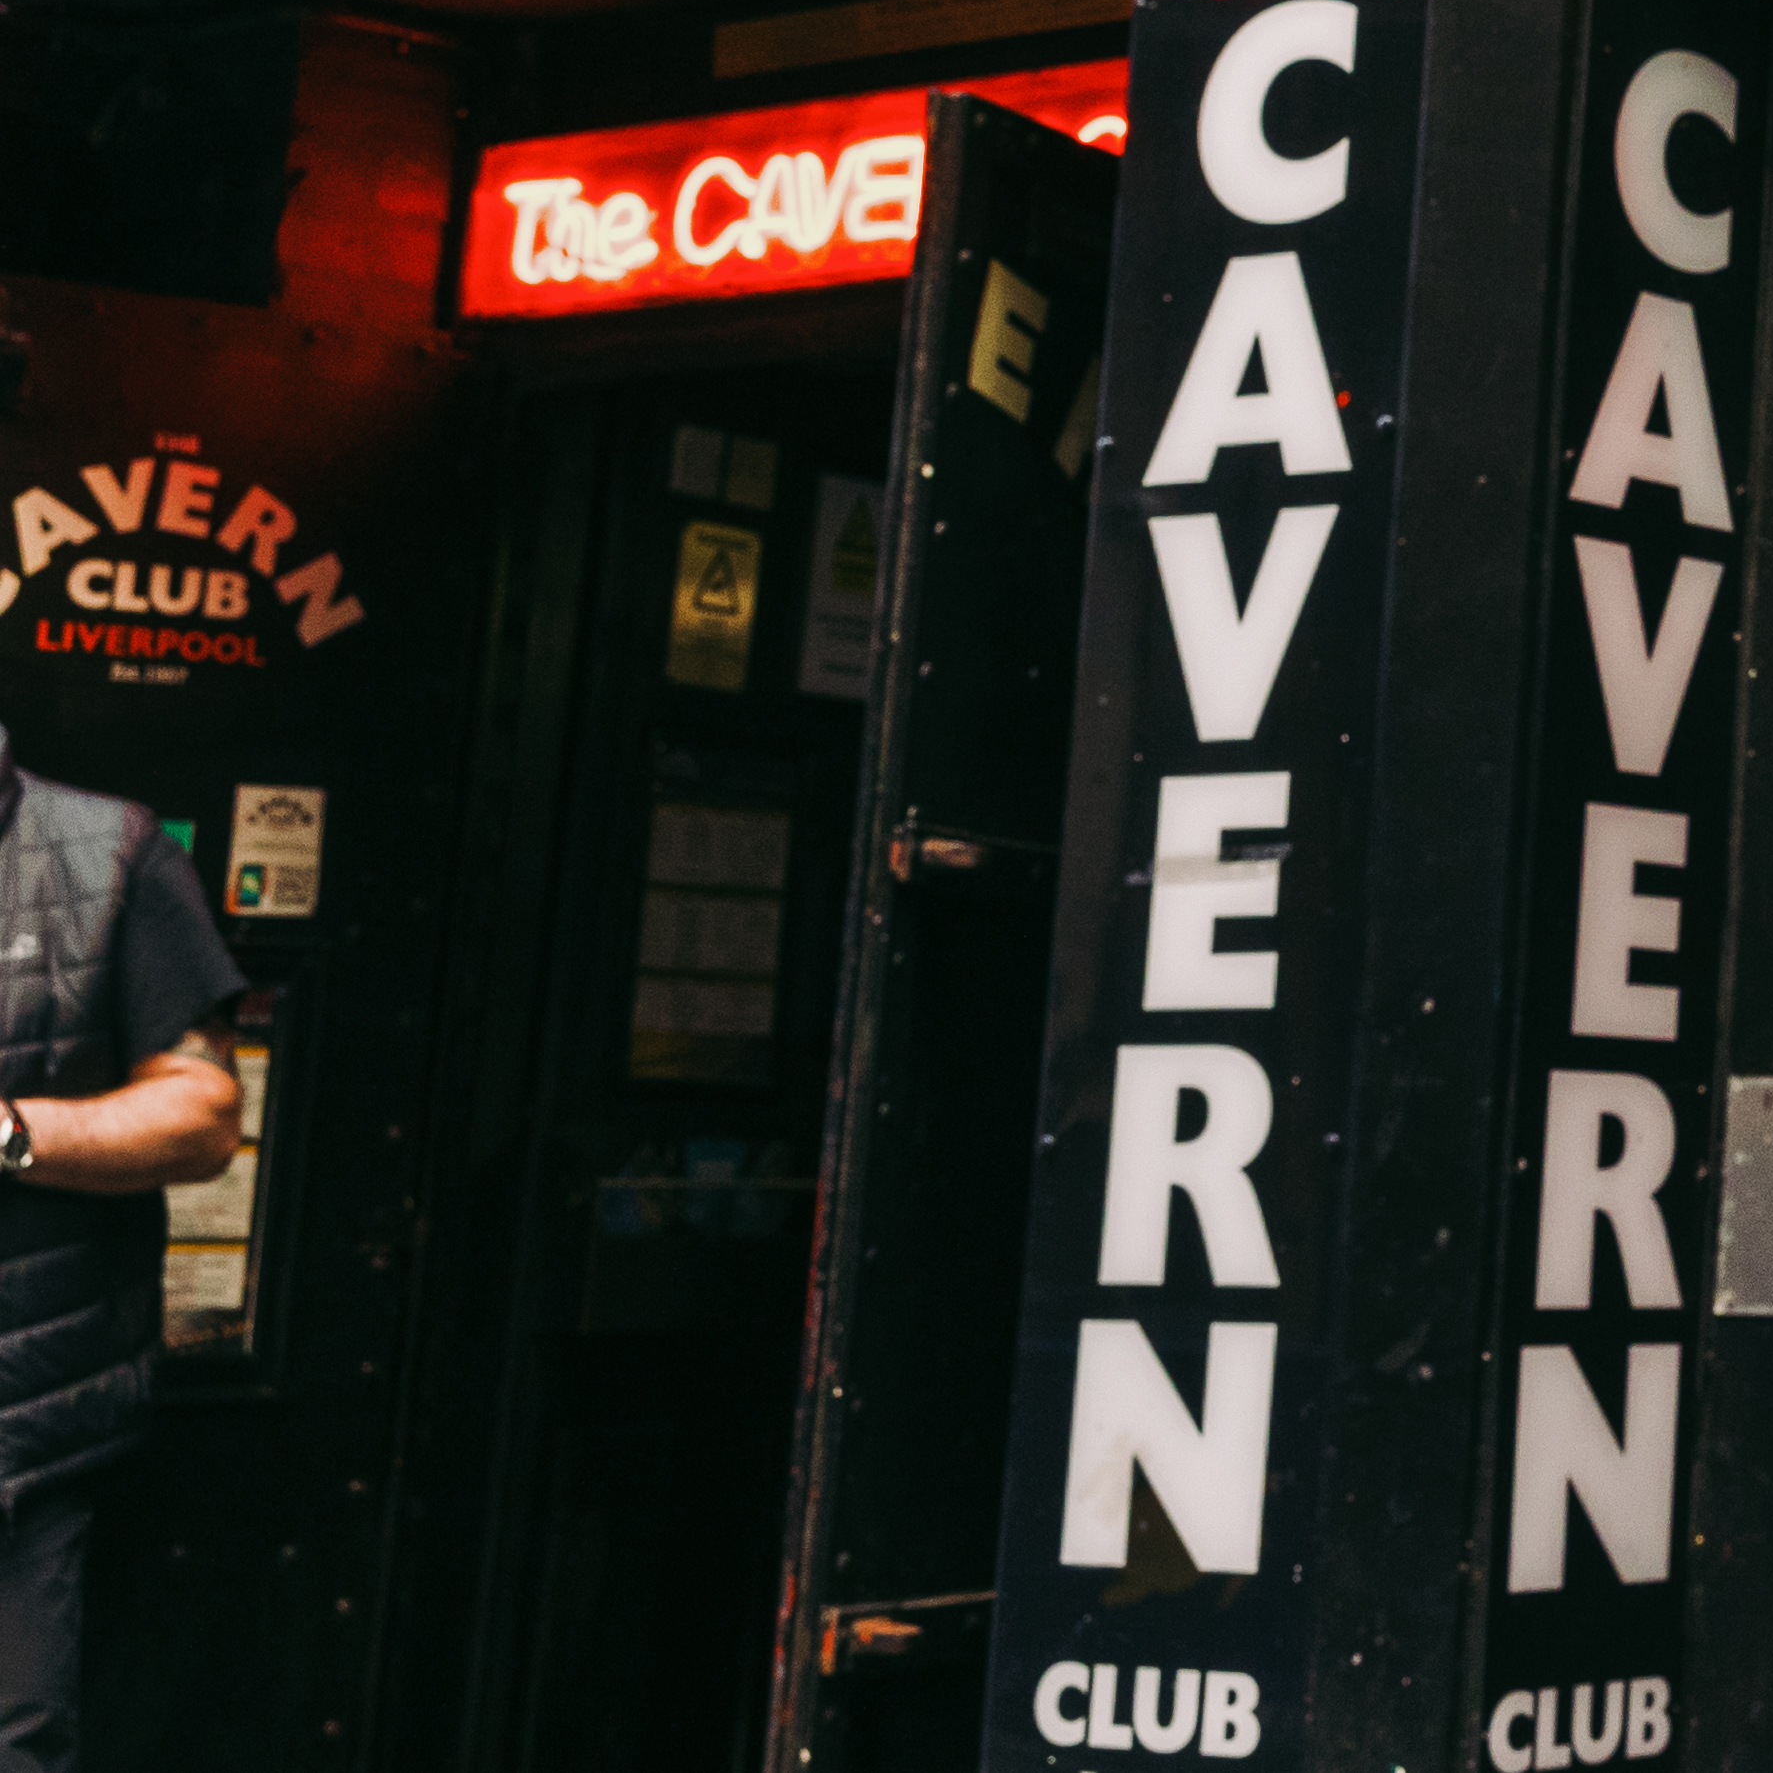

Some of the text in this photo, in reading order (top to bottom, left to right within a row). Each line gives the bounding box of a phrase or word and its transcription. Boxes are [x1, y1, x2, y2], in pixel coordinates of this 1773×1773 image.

[504, 134, 926, 284] The CAVE
[66, 557, 250, 620] CLUB
[36, 618, 267, 667] LIVERPOOL
[1508, 49, 1739, 1594] CAVERN
[1033, 1661, 1261, 1757] CLUB
[1487, 1676, 1672, 1773] CLUB
